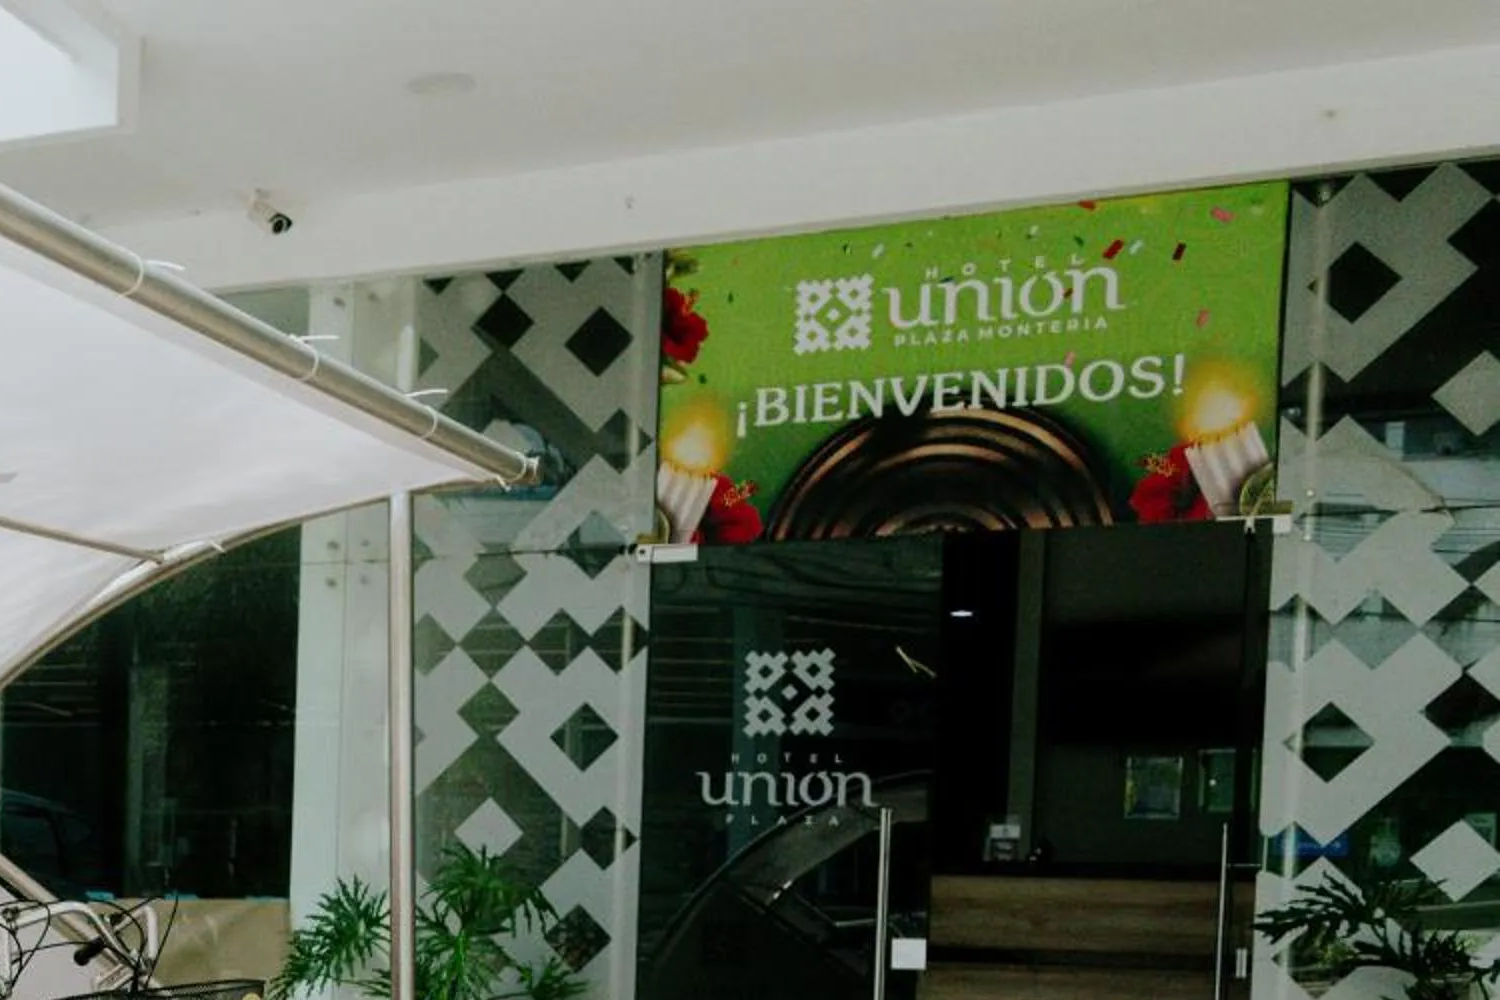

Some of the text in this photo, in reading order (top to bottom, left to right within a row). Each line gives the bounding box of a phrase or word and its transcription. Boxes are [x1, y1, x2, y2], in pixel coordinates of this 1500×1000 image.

[924, 253, 1086, 280] HOTEL
[893, 315, 1108, 348] PLAZA MONTERIA
[736, 353, 1185, 437] ¡BIENVENIDOS!
[731, 752, 843, 764] HOTEL
[725, 813, 840, 827] PLAZA
